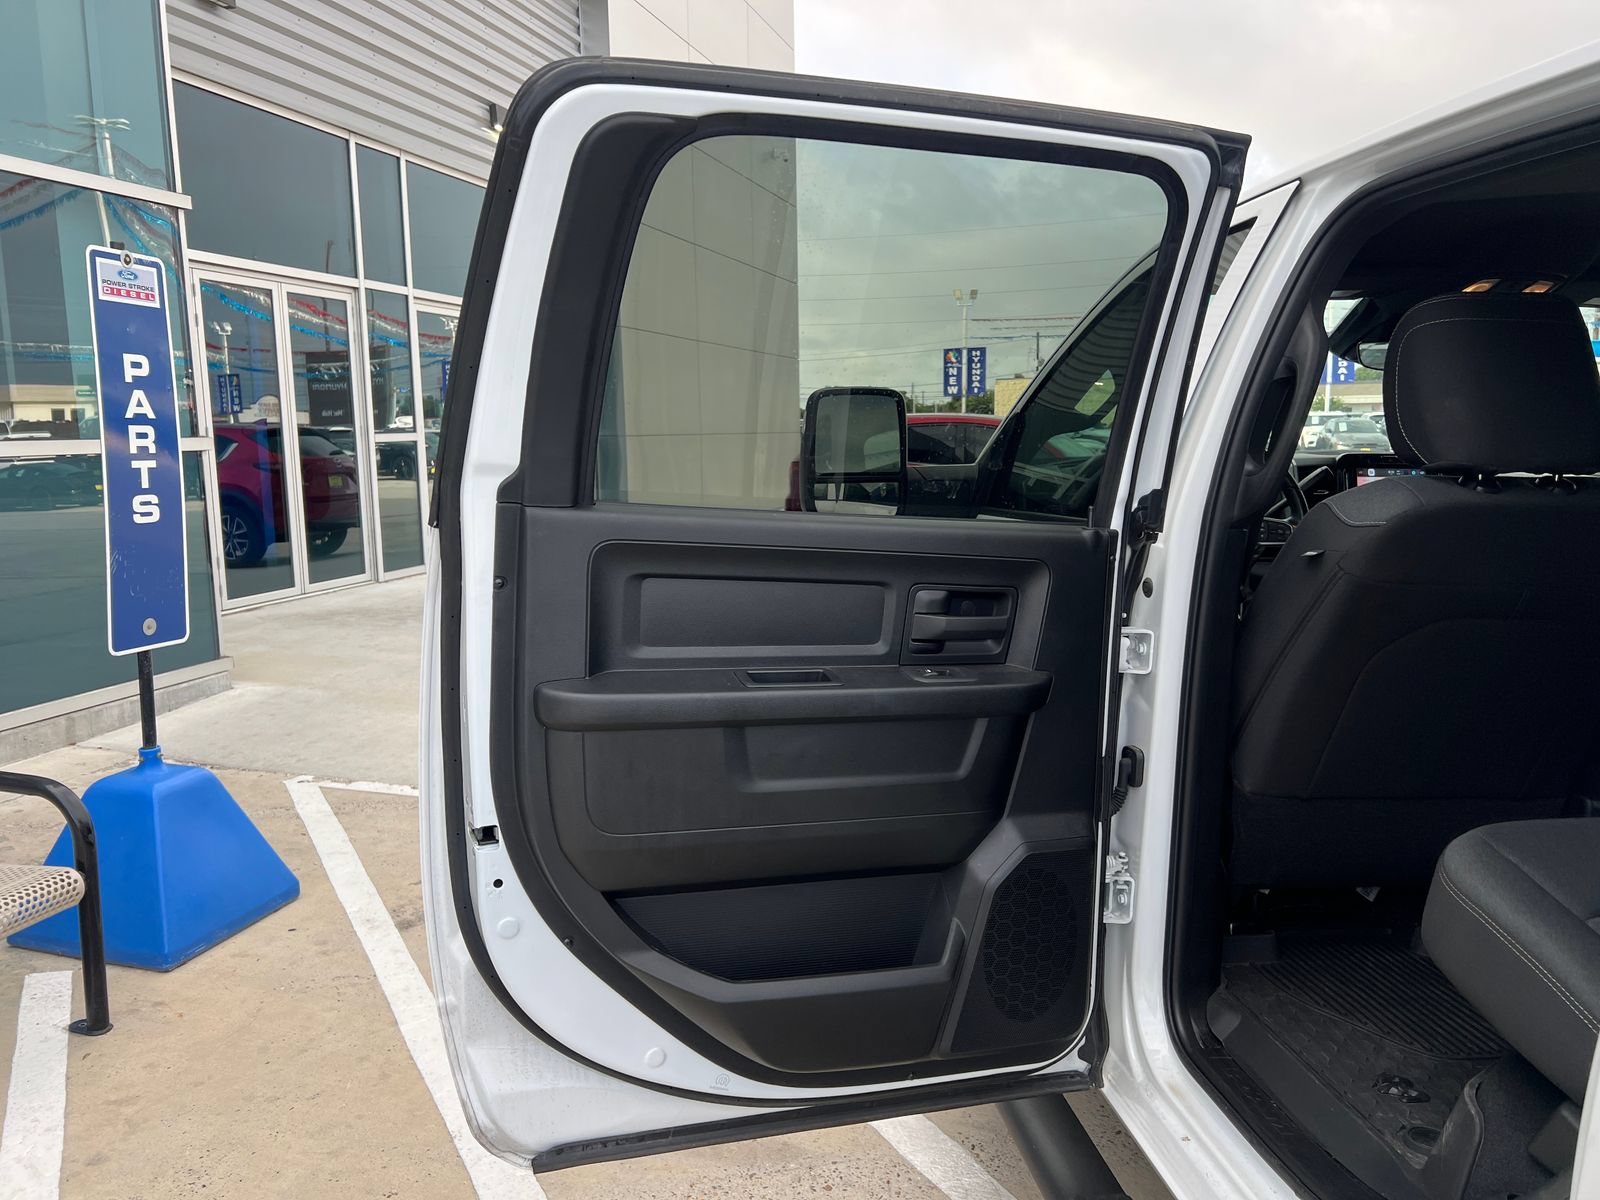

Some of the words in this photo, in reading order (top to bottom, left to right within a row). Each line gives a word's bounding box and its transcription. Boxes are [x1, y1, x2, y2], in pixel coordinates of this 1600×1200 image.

[102, 279, 127, 288] POWER
[128, 283, 155, 292] STROKE
[119, 270, 136, 280] Ford
[103, 286, 155, 301] DIESEL
[947, 367, 958, 394] NEW
[972, 351, 981, 393] HYUNDAI
[122, 353, 161, 524] PARTS
